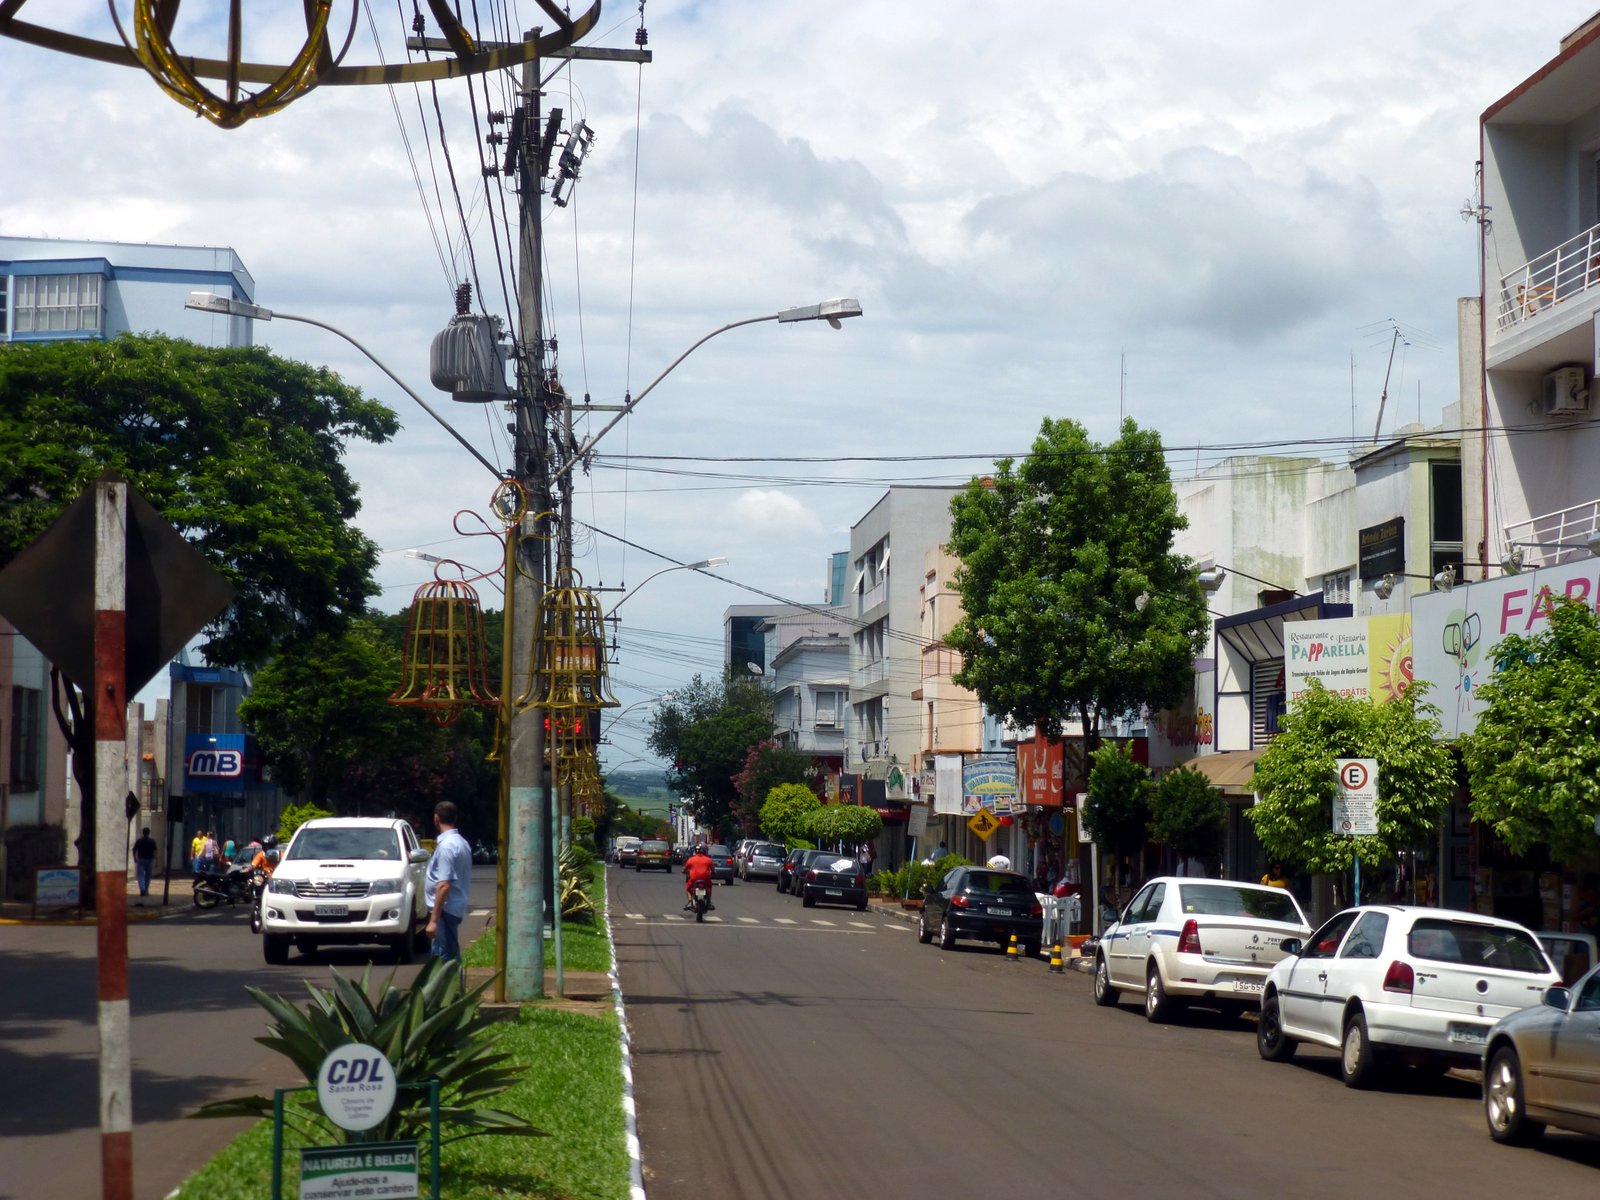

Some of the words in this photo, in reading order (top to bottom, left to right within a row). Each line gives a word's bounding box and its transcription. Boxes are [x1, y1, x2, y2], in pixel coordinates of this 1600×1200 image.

[1500, 574, 1600, 635] FAR
[1288, 633, 1329, 643] Restaurante
[1336, 634, 1366, 643] Pizzaria
[1291, 642, 1365, 662] PAPPARELLA
[1349, 769, 1359, 783] E
[327, 1058, 384, 1085] CDL
[328, 1085, 355, 1093] Santa
[359, 1083, 382, 1092] Rosa
[303, 1156, 364, 1171] NATUREZA
[365, 1153, 373, 1167] É
[374, 1153, 416, 1167] BELEZA
[331, 1176, 380, 1189] Ajude-nos
[382, 1176, 389, 1184] a
[303, 1188, 353, 1200] conservar
[355, 1186, 375, 1196] este
[377, 1184, 415, 1195] canteiro
